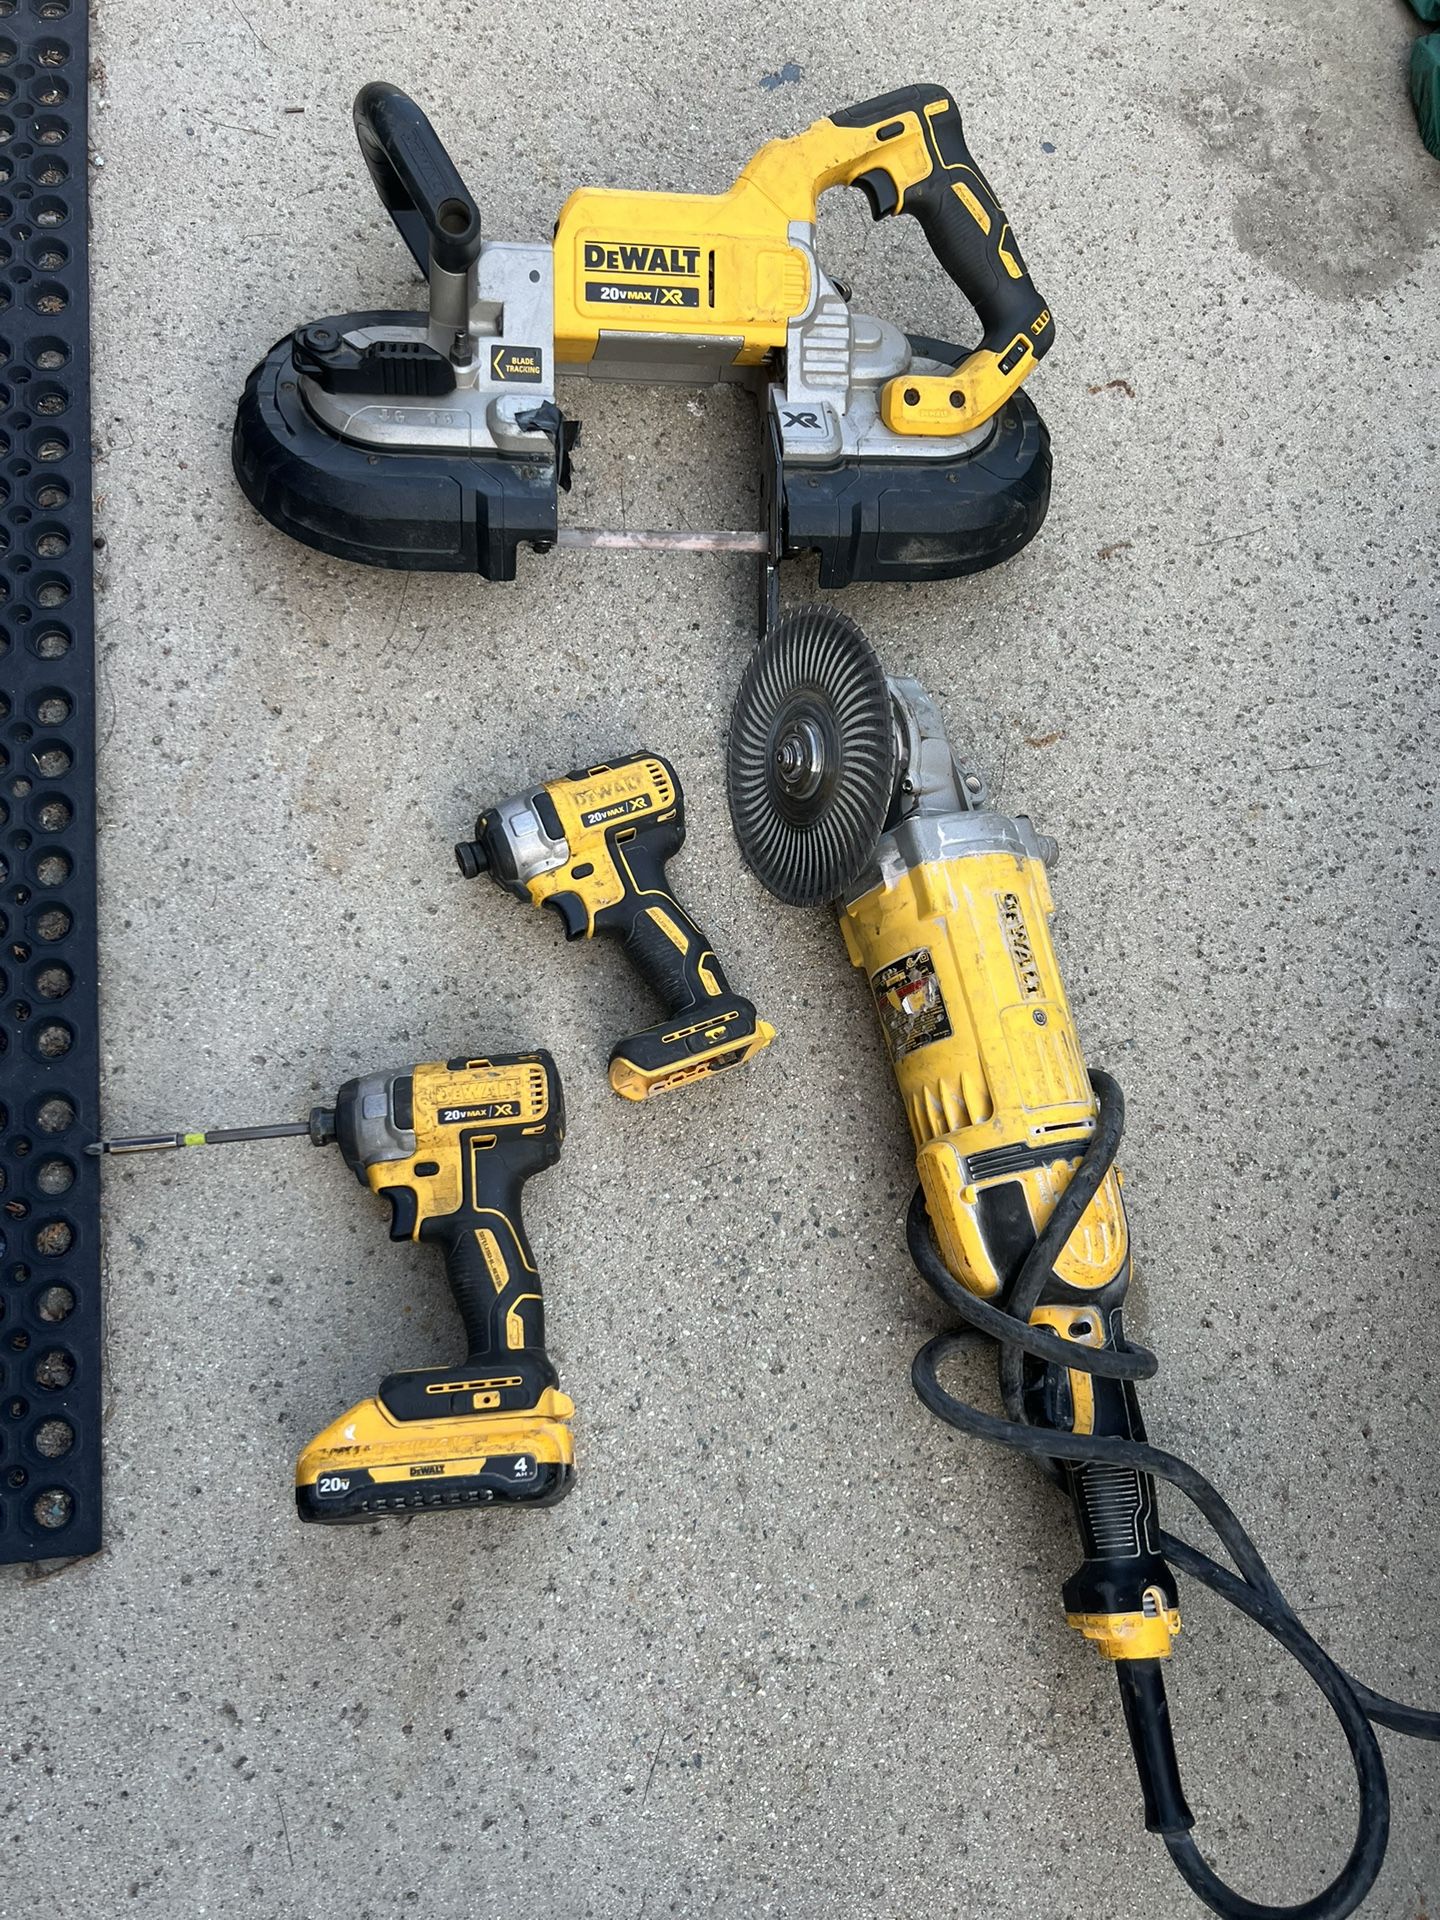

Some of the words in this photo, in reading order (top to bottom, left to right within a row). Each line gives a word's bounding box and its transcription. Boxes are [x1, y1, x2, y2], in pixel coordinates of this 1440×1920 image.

[660, 288, 684, 305] XR
[511, 357, 534, 366] BLADE
[505, 365, 540, 375] TRACKING
[782, 411, 822, 428] XR
[629, 797, 648, 811] XR
[494, 1104, 514, 1117] XR
[513, 1457, 528, 1472] 4
[320, 1477, 350, 1492] 20V
